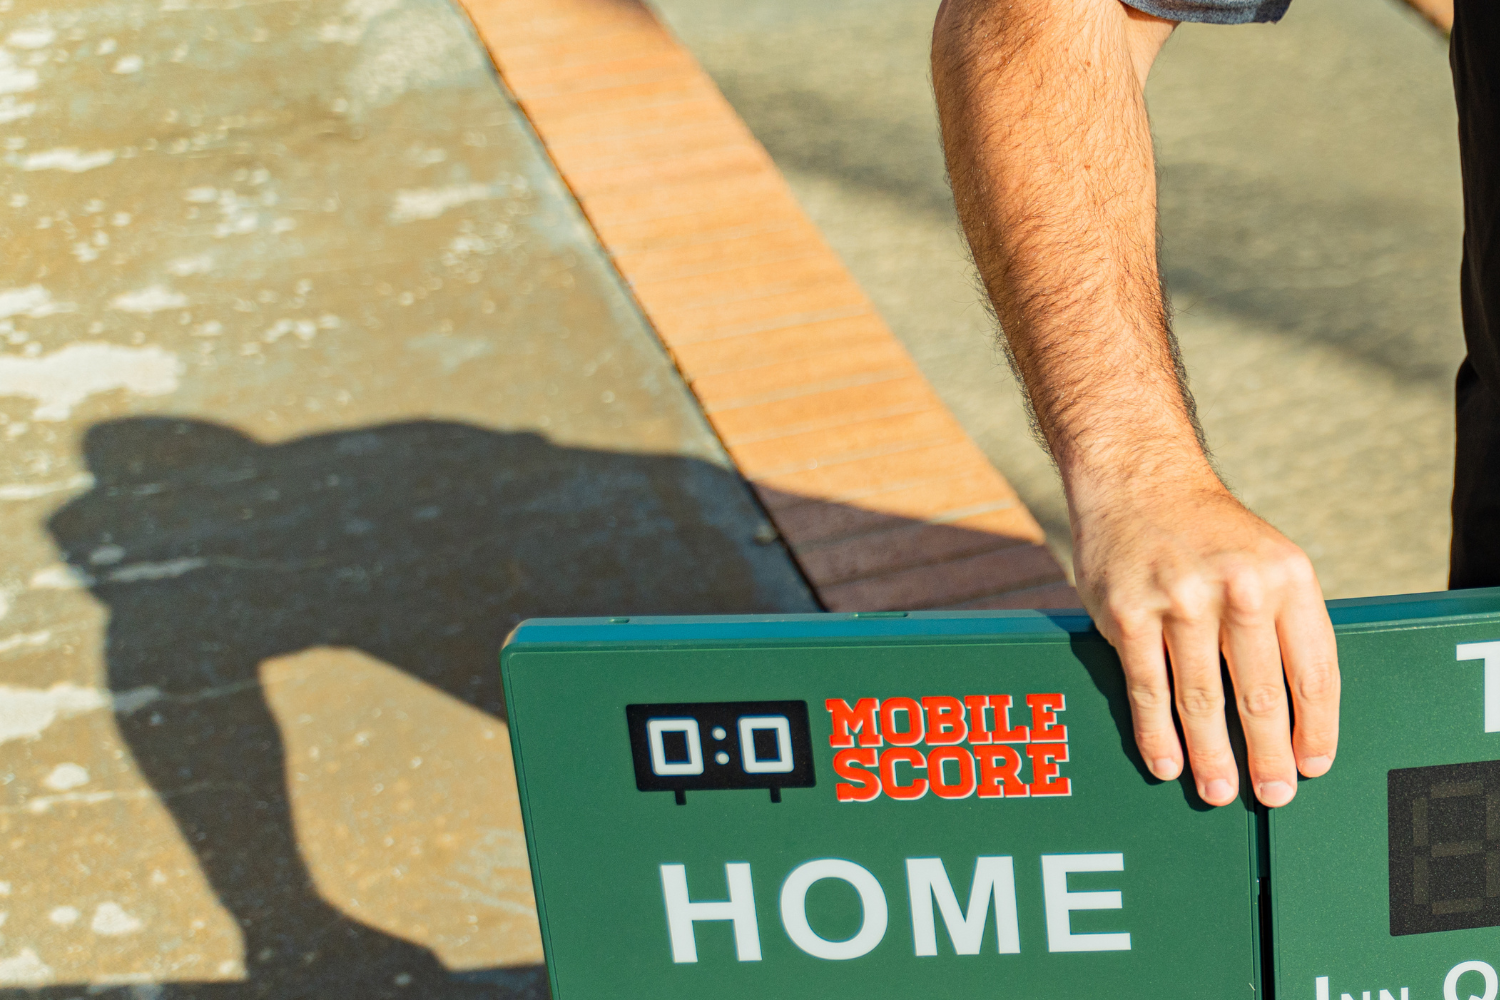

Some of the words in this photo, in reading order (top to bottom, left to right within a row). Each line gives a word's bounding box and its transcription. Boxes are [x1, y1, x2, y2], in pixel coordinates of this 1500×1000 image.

[825, 693, 1068, 748] MOBILE
[832, 743, 1072, 802] SCORE
[660, 852, 1132, 963] HOME
